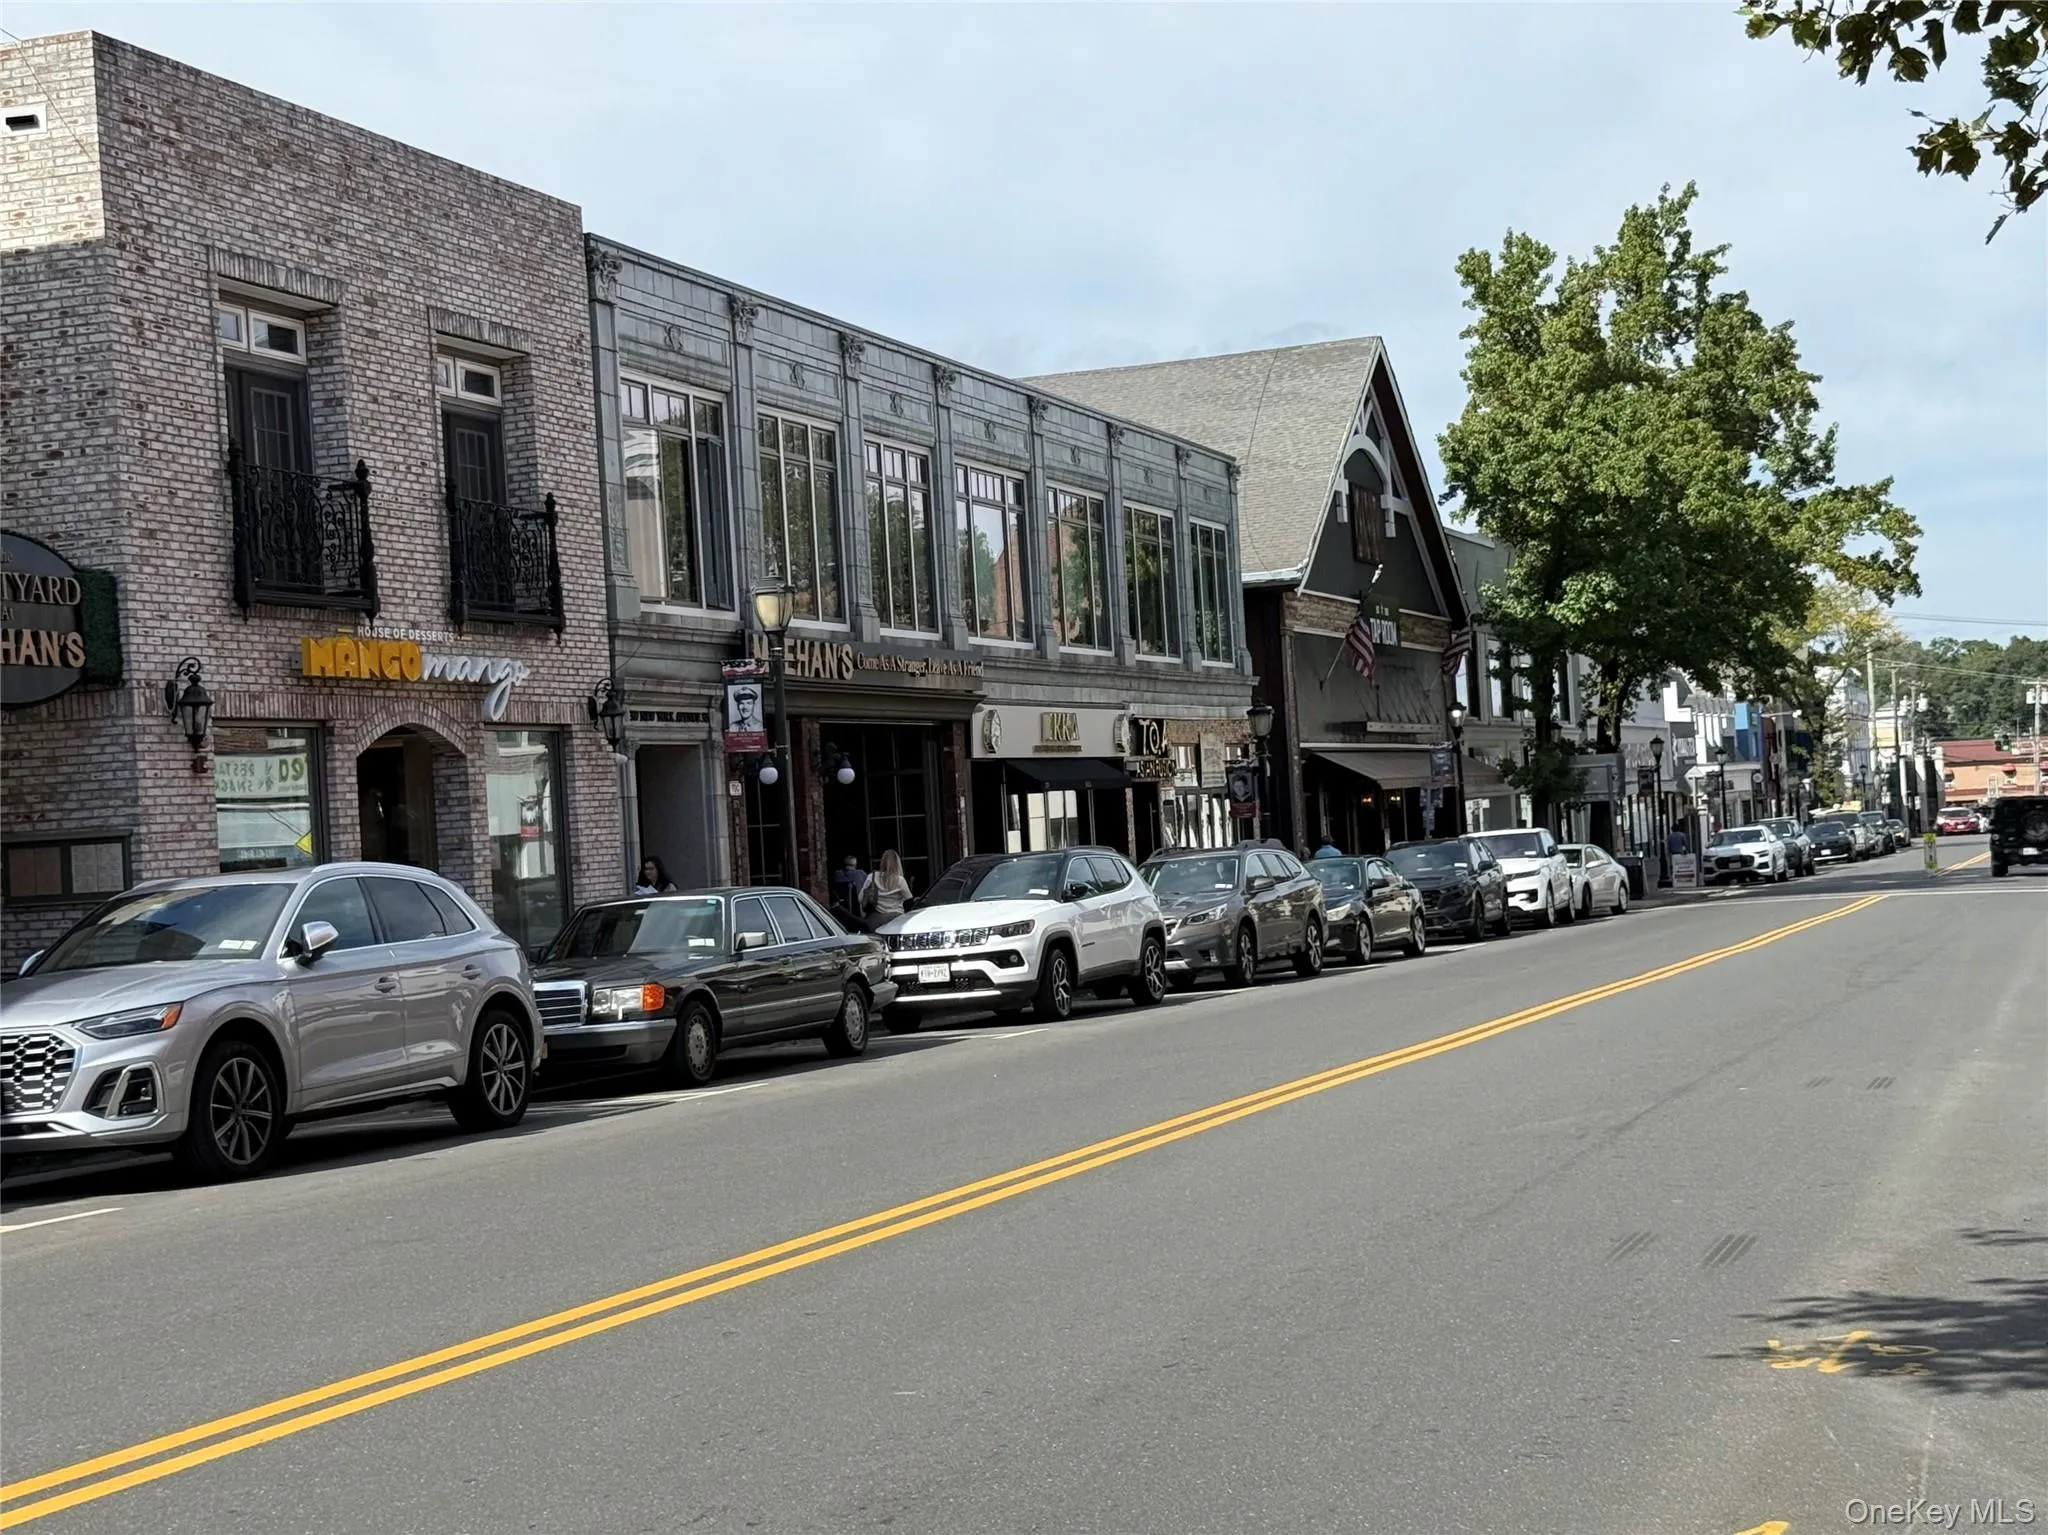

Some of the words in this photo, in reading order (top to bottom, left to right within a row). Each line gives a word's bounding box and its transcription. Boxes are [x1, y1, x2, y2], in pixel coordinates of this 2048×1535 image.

[357, 626, 391, 639] HOUSE
[393, 627, 407, 640] OF
[408, 628, 455, 643] DESSERTS
[753, 633, 854, 680] MEHAN'S
[301, 636, 422, 682] MANGO
[421, 653, 531, 721] mango
